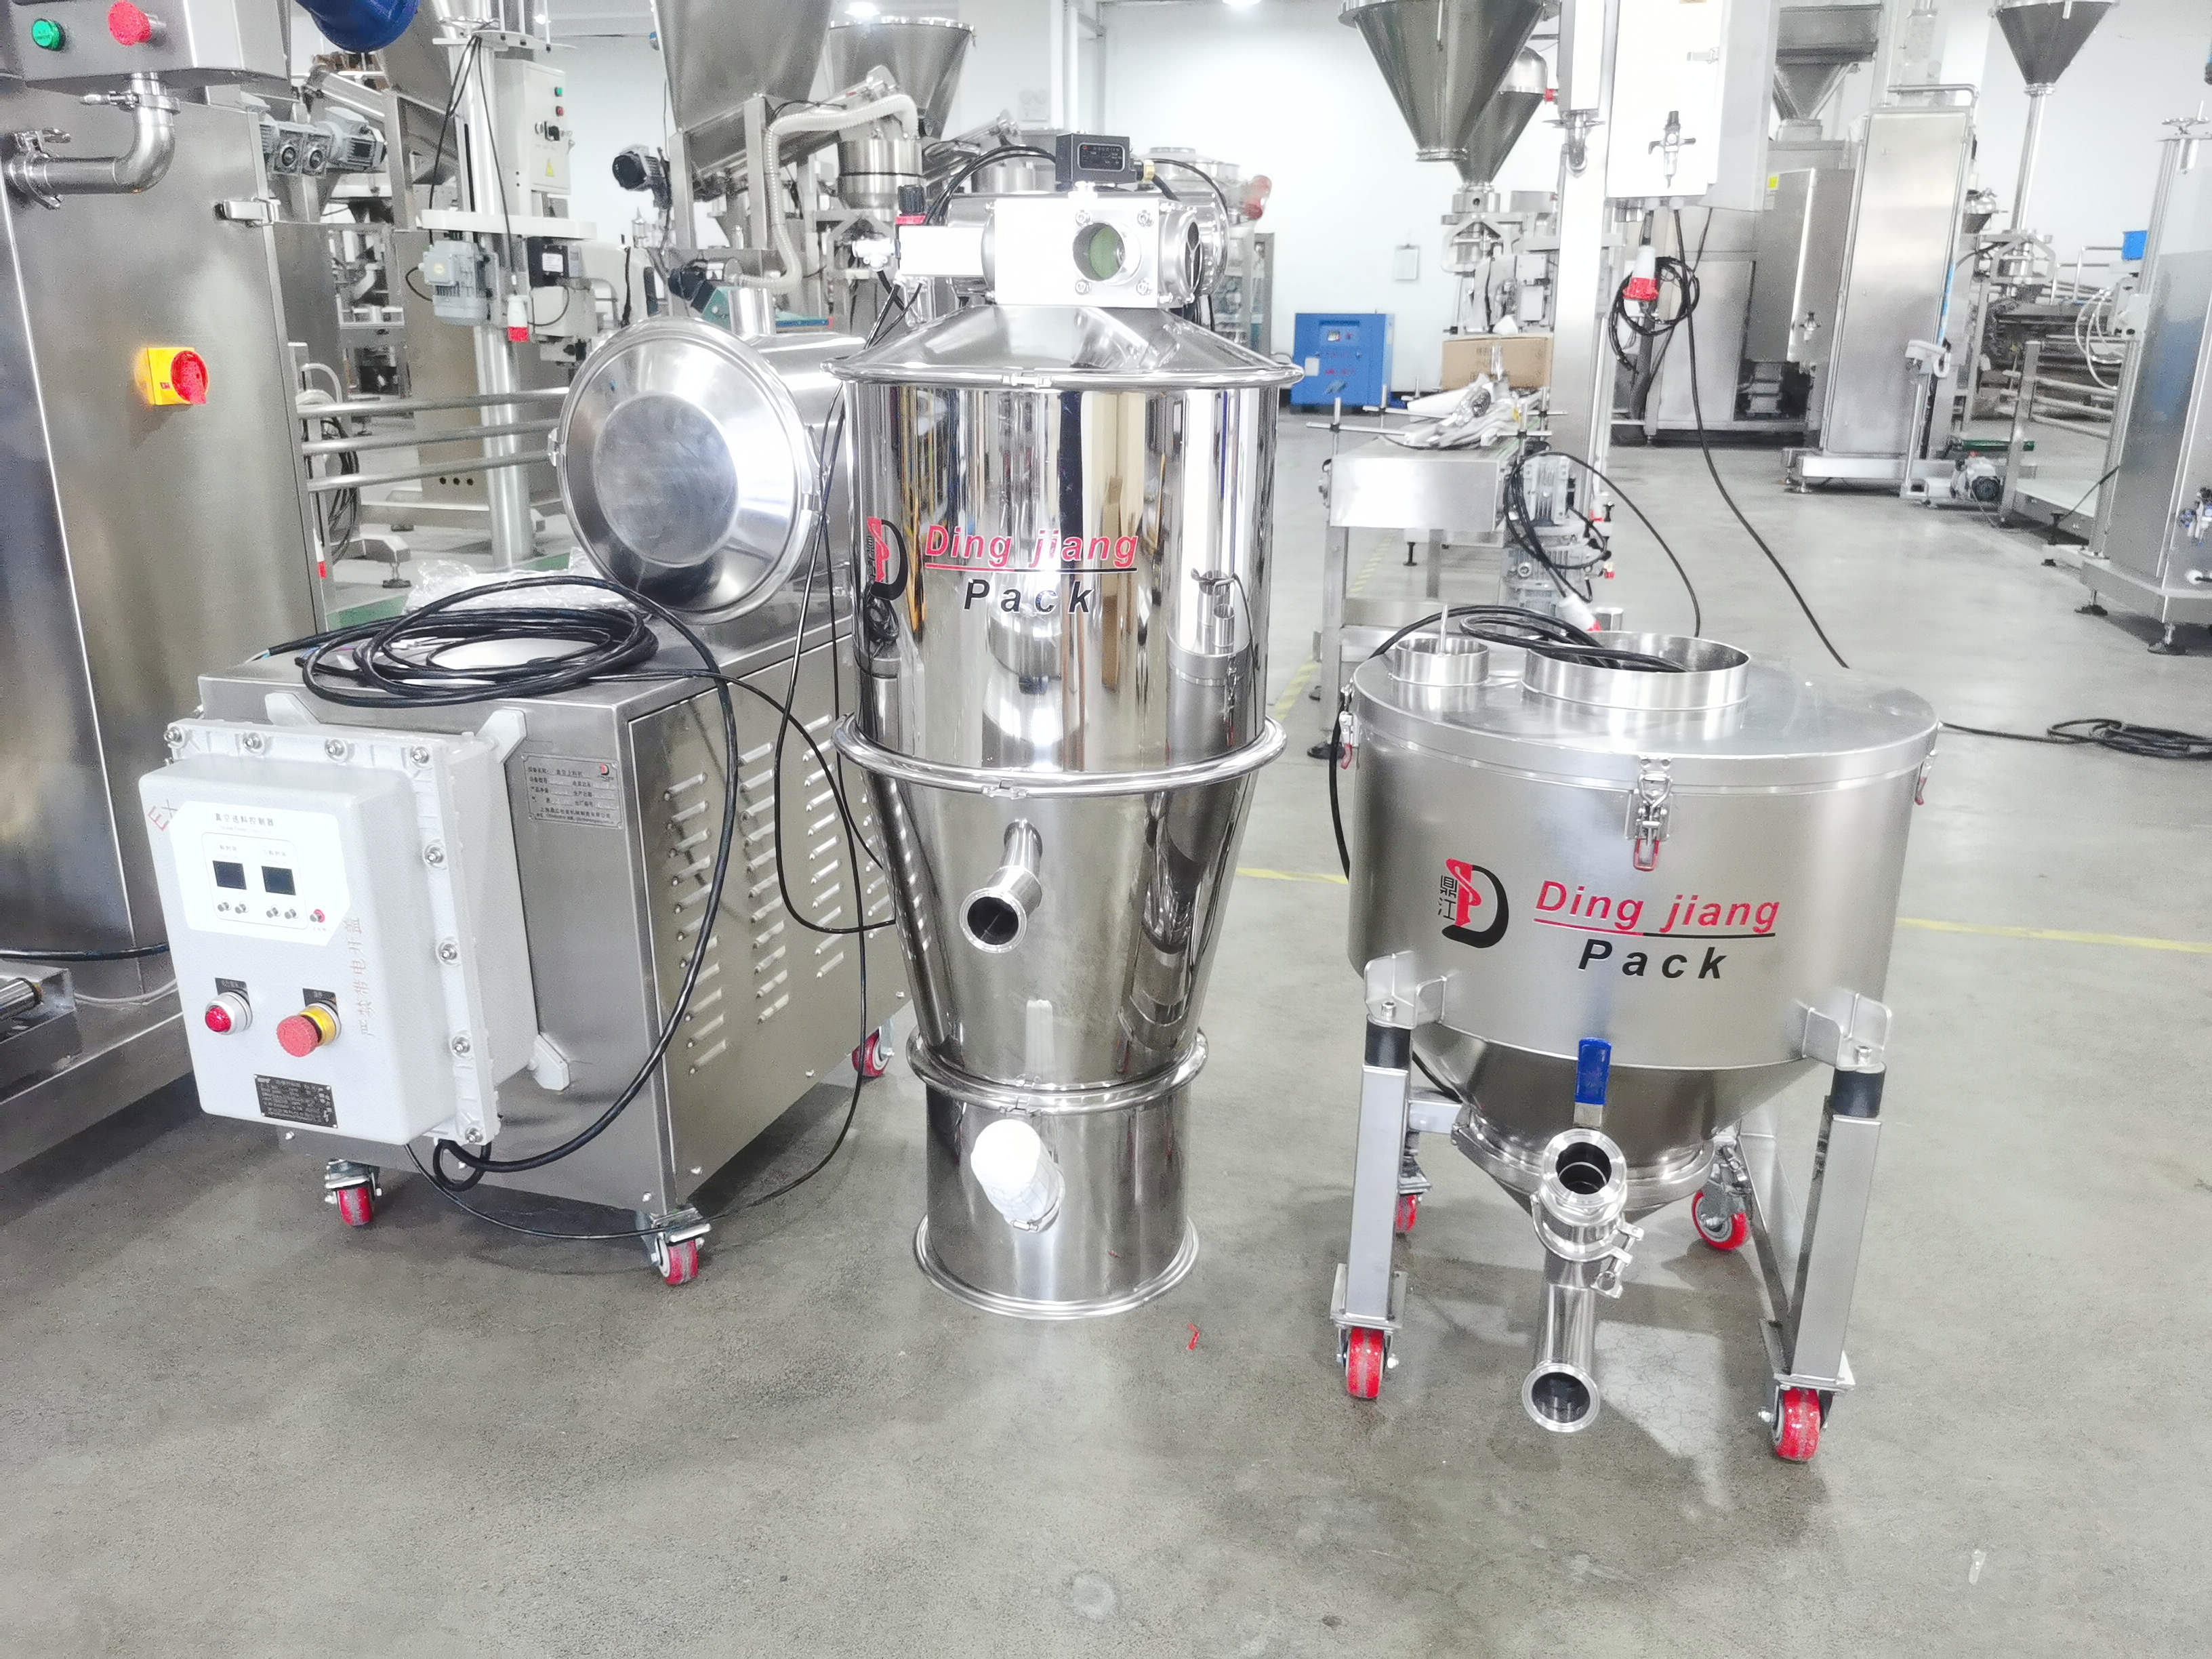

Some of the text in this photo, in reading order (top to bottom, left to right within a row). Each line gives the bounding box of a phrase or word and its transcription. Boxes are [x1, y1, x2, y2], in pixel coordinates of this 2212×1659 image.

[925, 525, 1138, 568] Ding jiang
[964, 578, 1094, 613] Pack
[1437, 874, 1458, 921] 鼎江
[1535, 880, 1780, 934] Ding jiang
[1578, 938, 1727, 979] Pack
